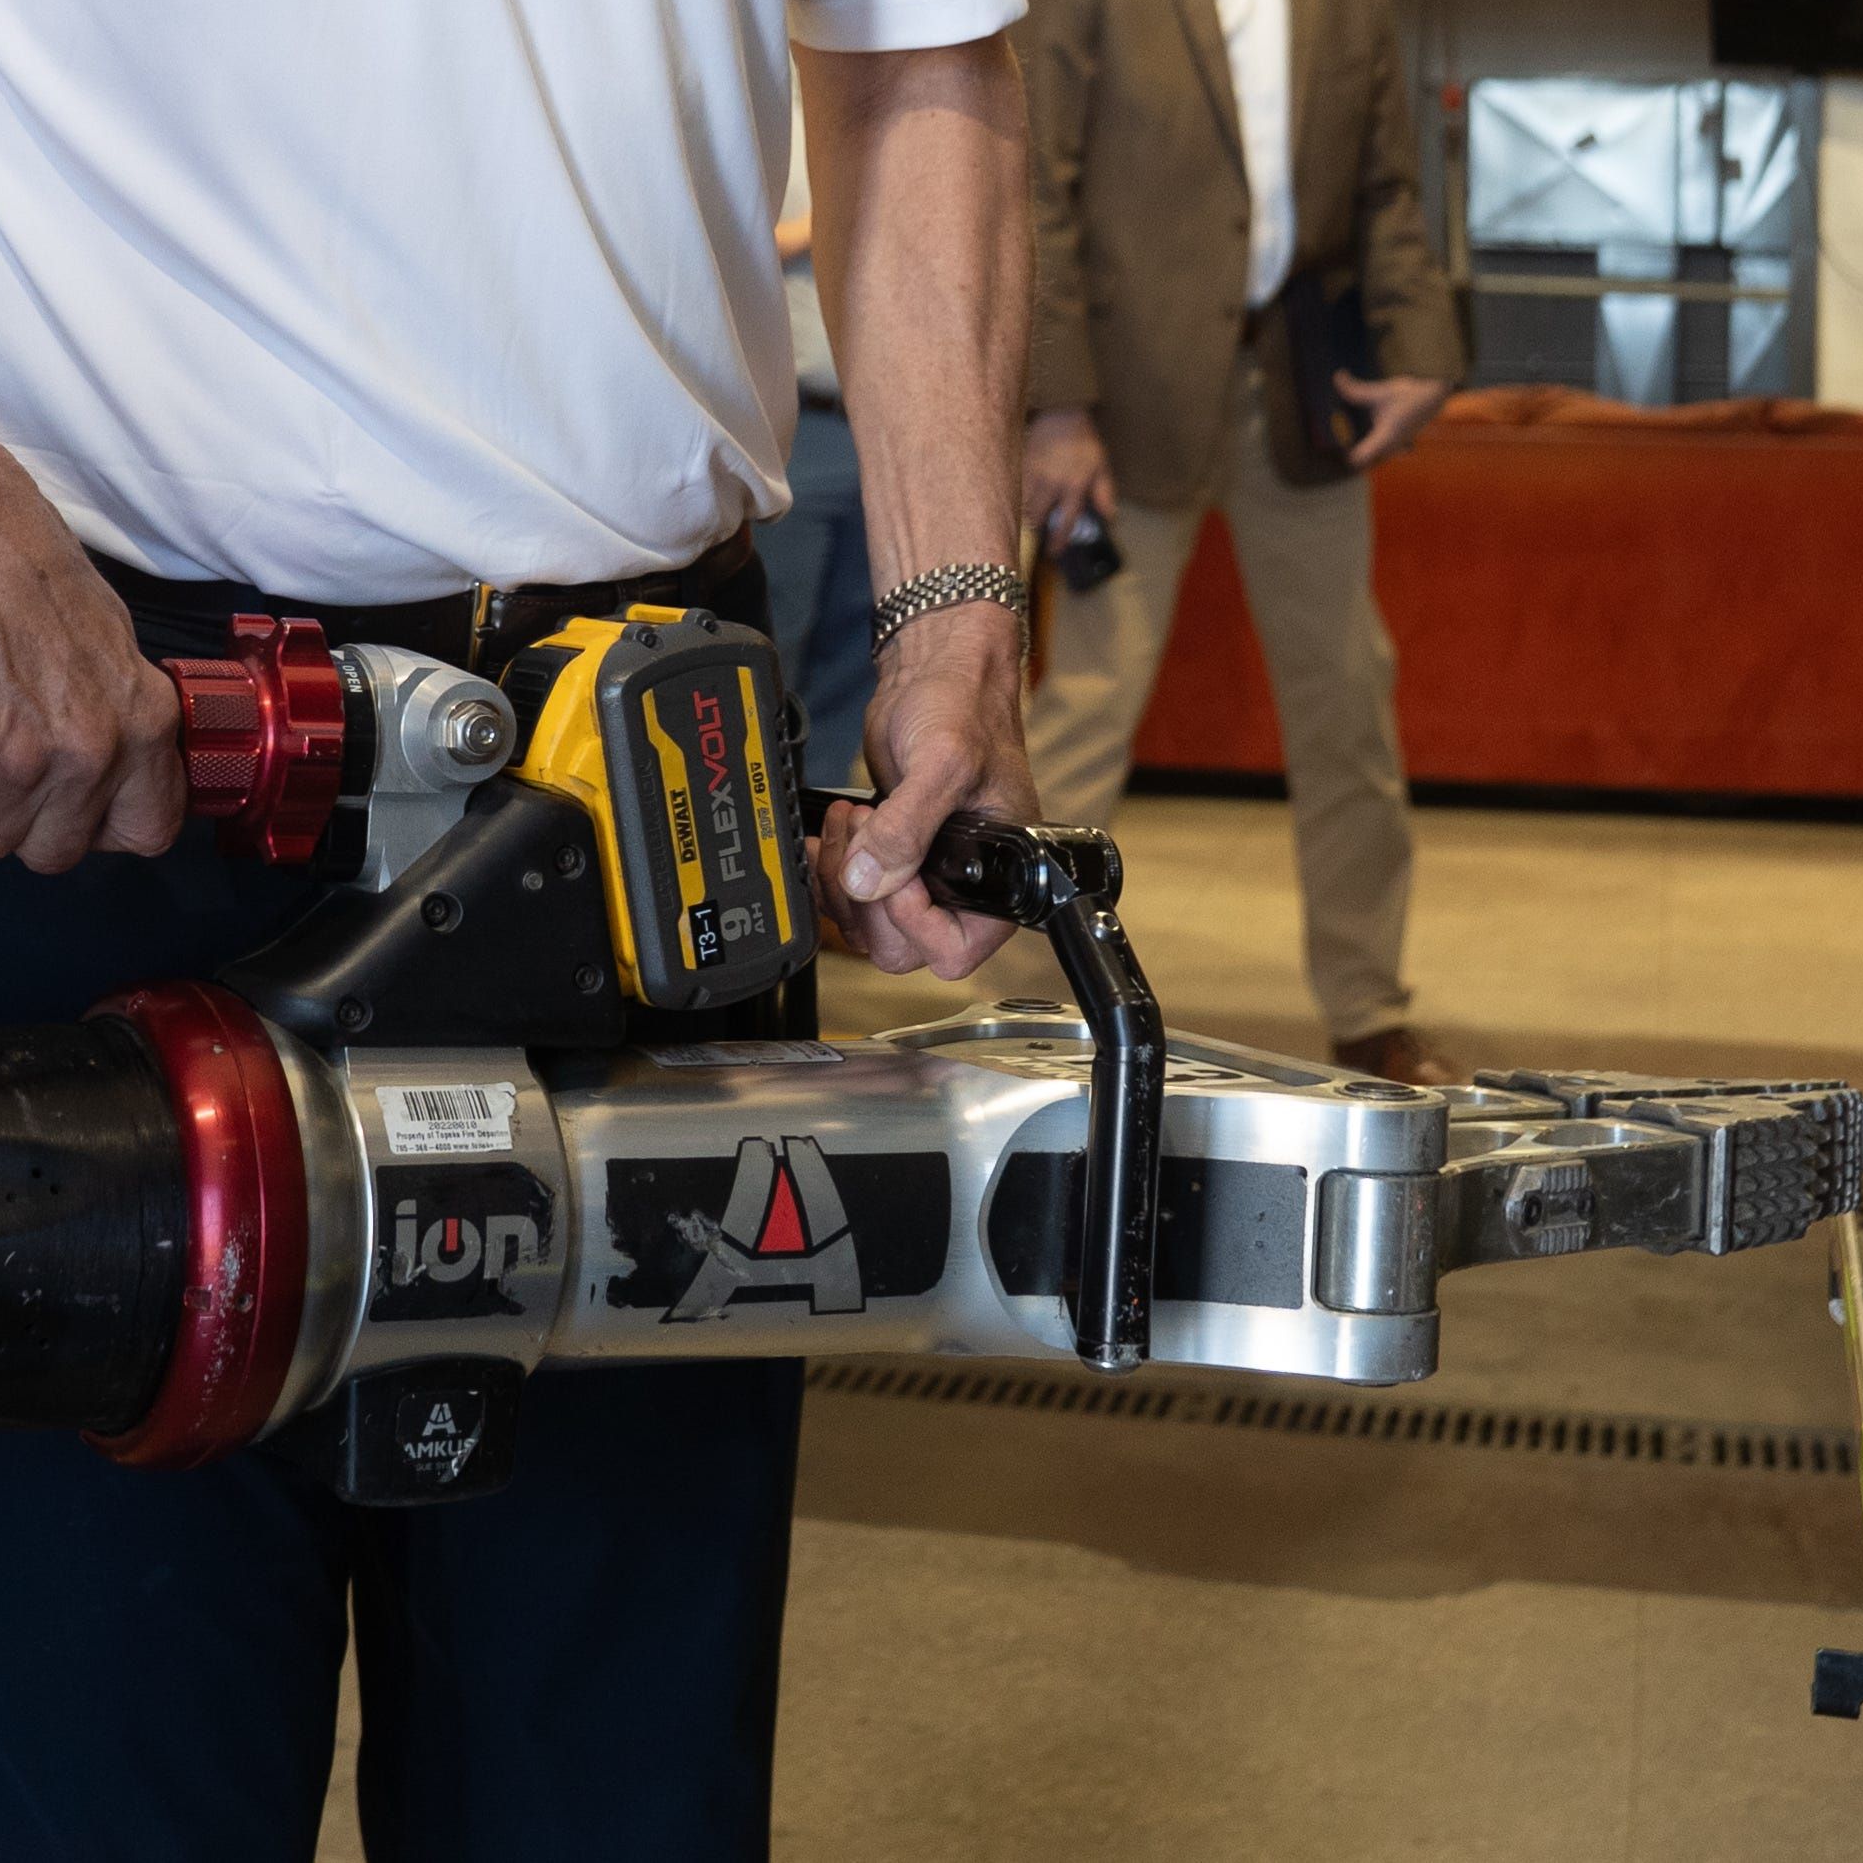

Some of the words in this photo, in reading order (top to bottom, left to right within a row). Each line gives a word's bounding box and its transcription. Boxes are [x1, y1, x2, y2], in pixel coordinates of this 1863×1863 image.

[341, 664, 364, 694] OPEN
[692, 688, 747, 884] FLEXVOLT
[694, 906, 719, 964] T3-1
[720, 906, 754, 943] 9
[751, 901, 767, 935] AH
[396, 1131, 426, 1141] Property
[435, 1129, 461, 1140] Topeka
[390, 1198, 539, 1285] ion
